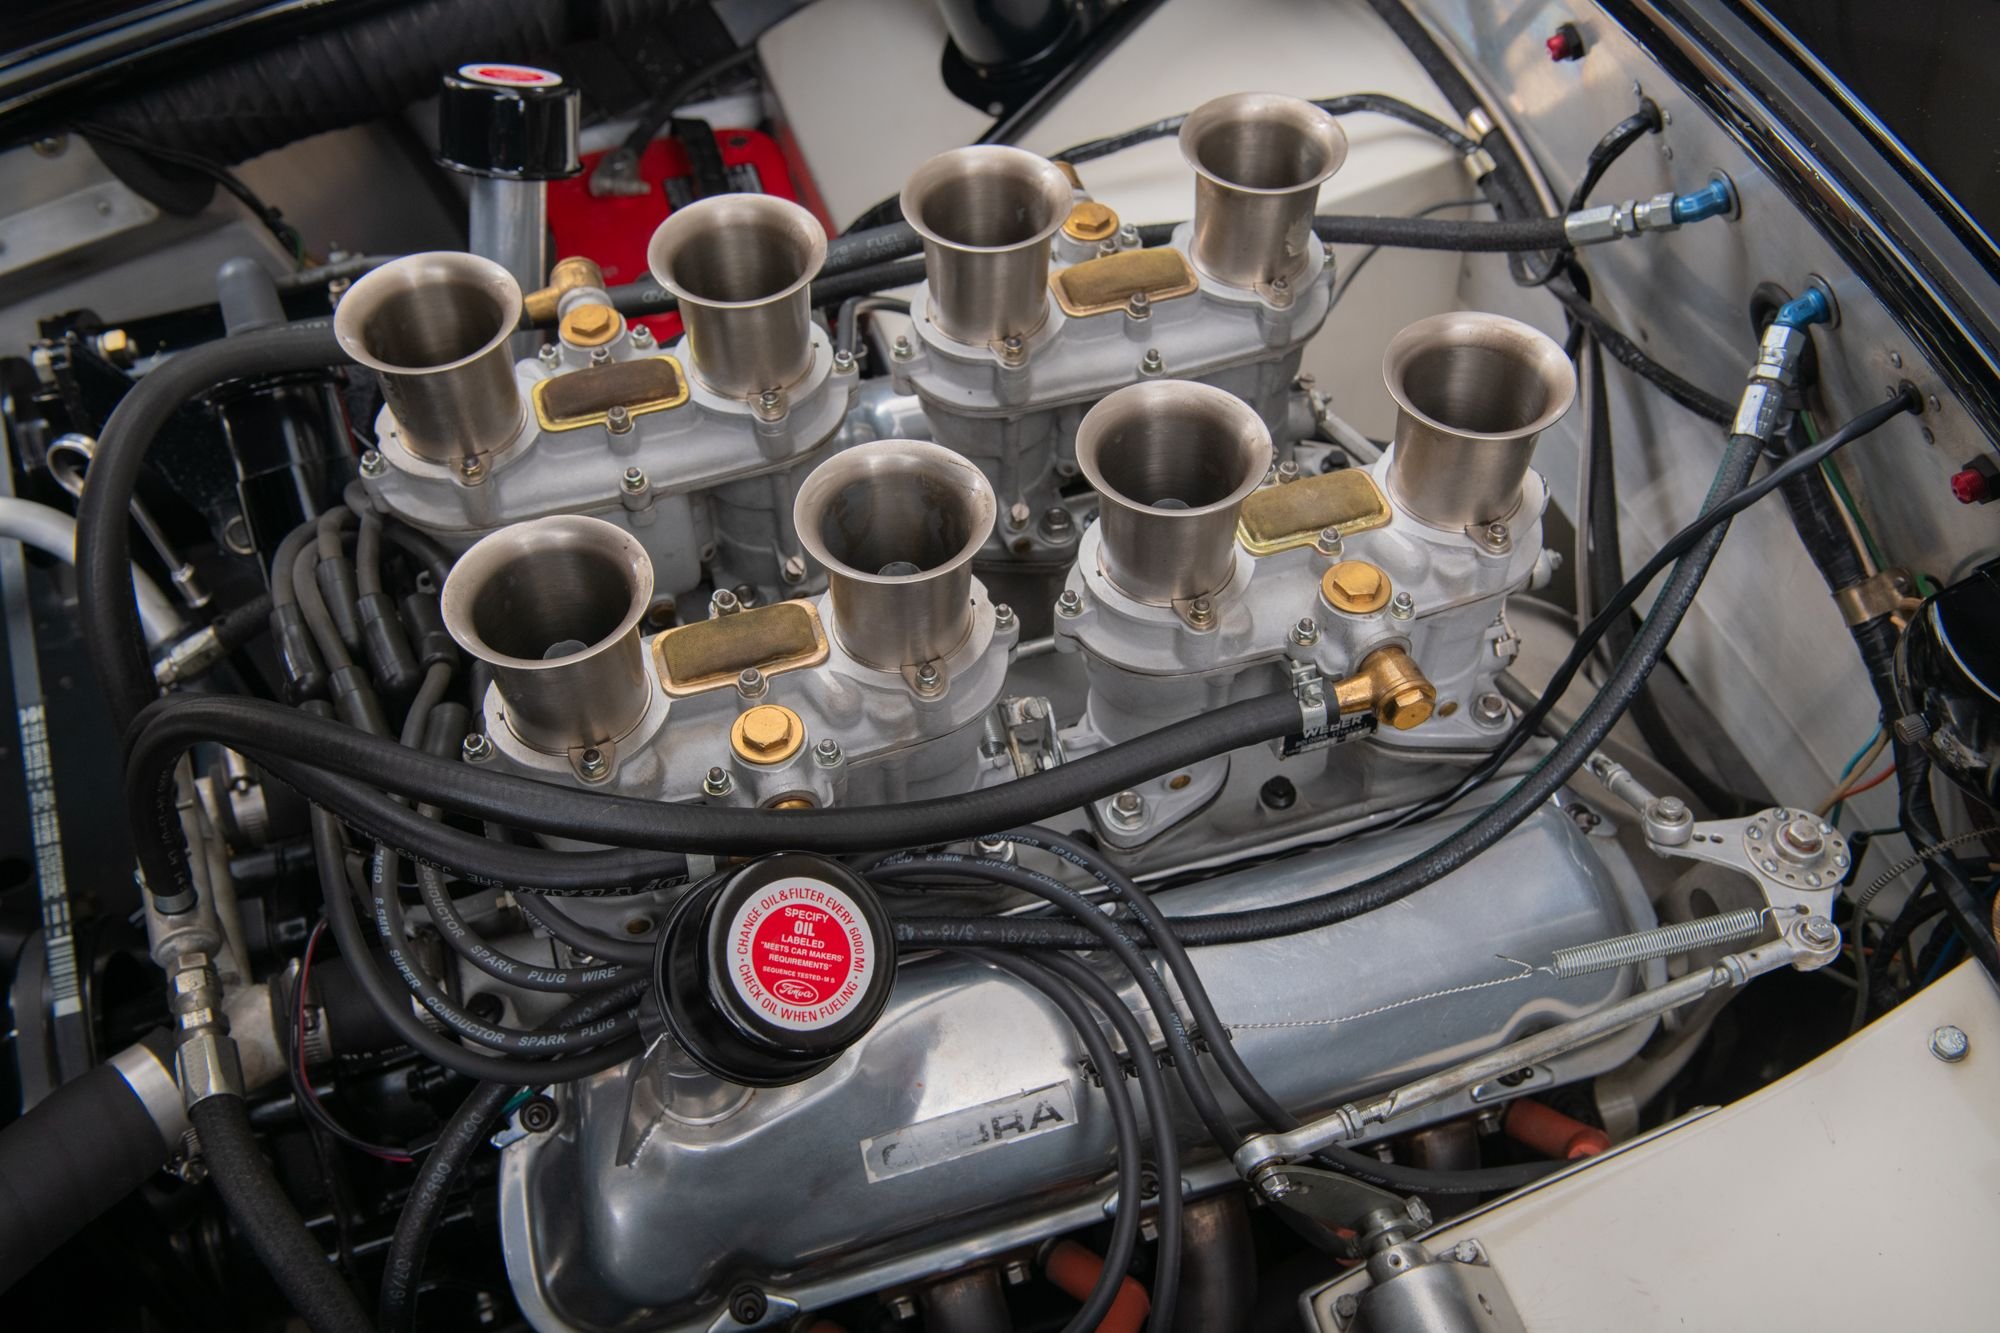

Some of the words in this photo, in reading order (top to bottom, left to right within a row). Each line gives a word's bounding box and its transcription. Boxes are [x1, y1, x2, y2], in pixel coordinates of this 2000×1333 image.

[866, 232, 902, 249] FUEL
[1304, 715, 1362, 738] WEBER
[975, 857, 1017, 873] SUPER
[784, 907, 830, 924] SPECIFY
[825, 896, 856, 926] EVERY
[736, 907, 762, 955] CHANGE
[793, 920, 815, 938] OIL
[761, 941, 789, 954] "MEETS
[791, 947, 808, 957] CAR
[781, 934, 825, 950] LABELED
[849, 926, 865, 956] 6000
[470, 943, 518, 975] SPARK
[527, 969, 567, 984] PLUG
[581, 964, 623, 983] WIRE"
[762, 965, 796, 977] SEQUENCE
[768, 954, 832, 971] REQUIREMENTS"
[856, 957, 866, 974] MI
[375, 897, 391, 937] 8.5MM
[389, 948, 422, 990] SUPER
[425, 995, 506, 1044] CONDUCTOR
[518, 1032, 568, 1047] SPARK
[580, 1017, 616, 1038] PLUG
[738, 964, 764, 1001] CHECK
[761, 997, 778, 1017] OIL
[780, 1007, 818, 1023] WHEN
[819, 983, 859, 1019] FUELING
[881, 1099, 1065, 1169] CRA
